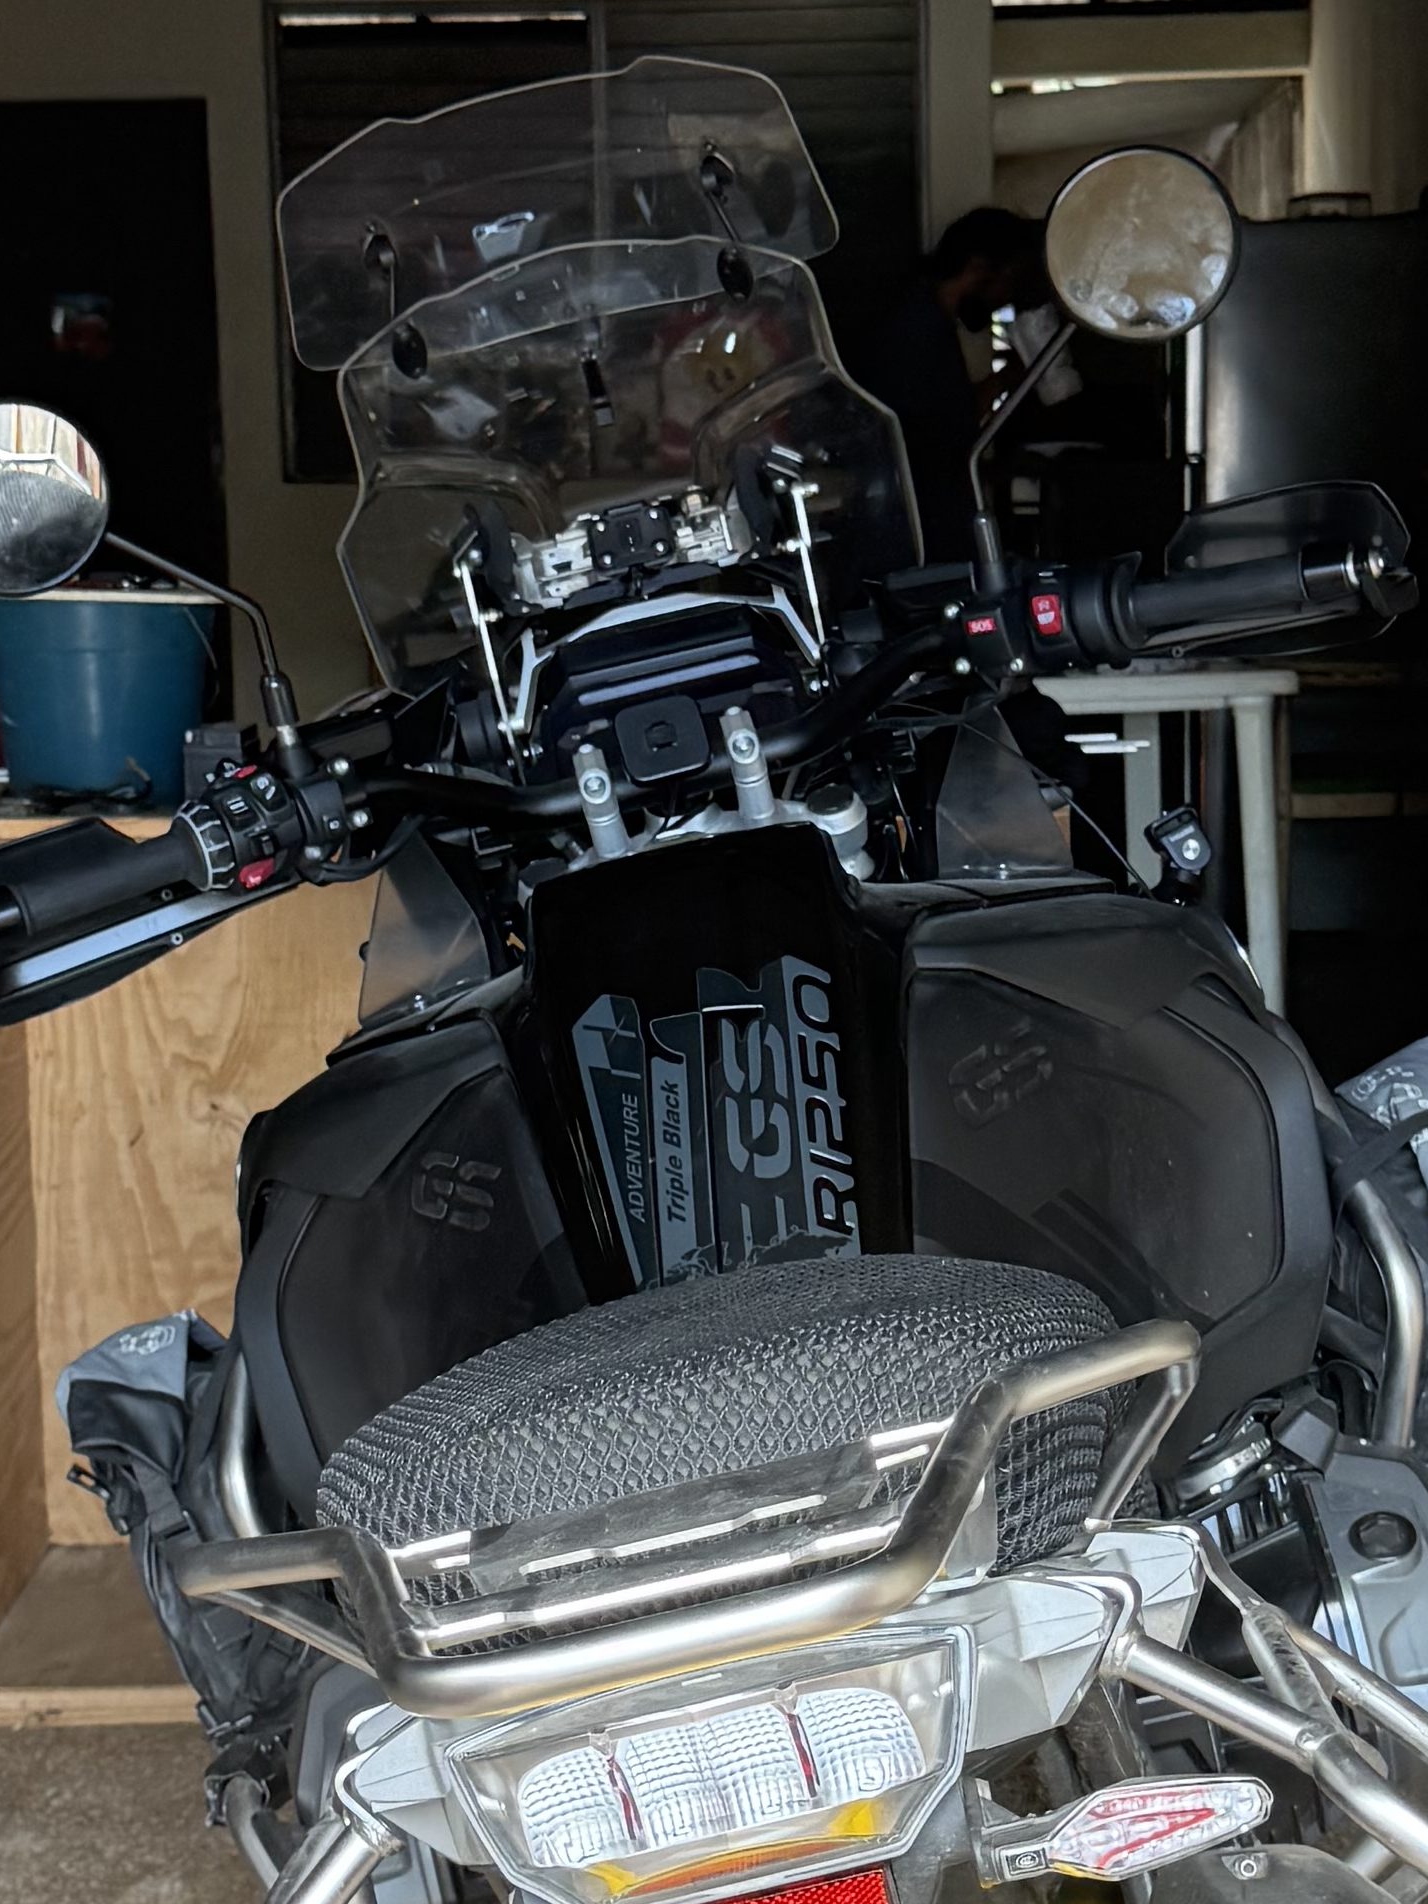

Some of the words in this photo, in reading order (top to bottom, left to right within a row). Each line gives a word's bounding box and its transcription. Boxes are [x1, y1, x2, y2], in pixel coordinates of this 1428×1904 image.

[664, 1079, 682, 1149] Black
[721, 1018, 792, 1179] GS
[411, 1151, 502, 1232] GS
[623, 1092, 646, 1224] ADVENTURE
[667, 1155, 691, 1224] Triple
